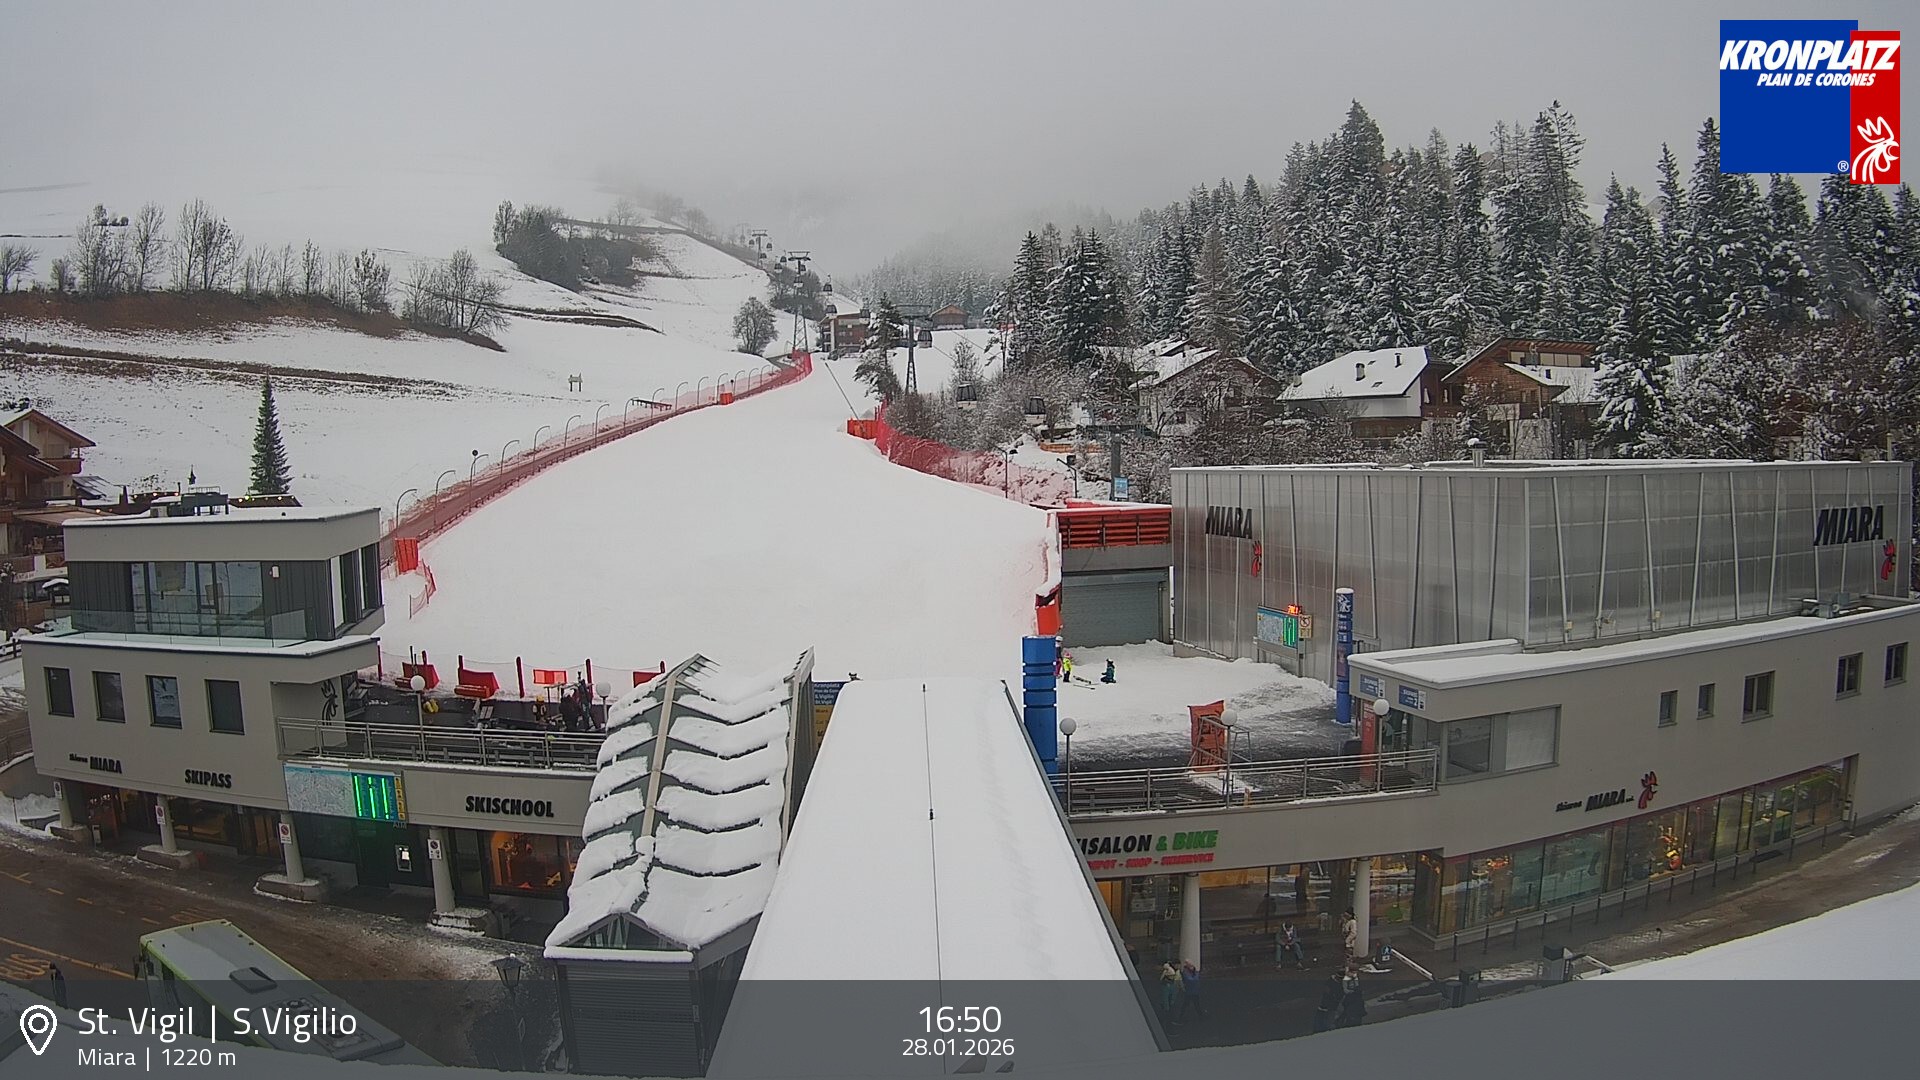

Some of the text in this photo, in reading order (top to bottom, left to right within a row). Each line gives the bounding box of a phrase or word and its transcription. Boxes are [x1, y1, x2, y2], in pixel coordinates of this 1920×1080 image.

[1205, 505, 1252, 539] MIARA
[1813, 505, 1884, 547] MIARA
[90, 756, 122, 774] MIARA
[184, 769, 232, 788] SKIPASS
[465, 796, 554, 817] SKISCHOOL
[1585, 788, 1626, 812] MIARA
[1076, 830, 1219, 855] ISALON & BIKE
